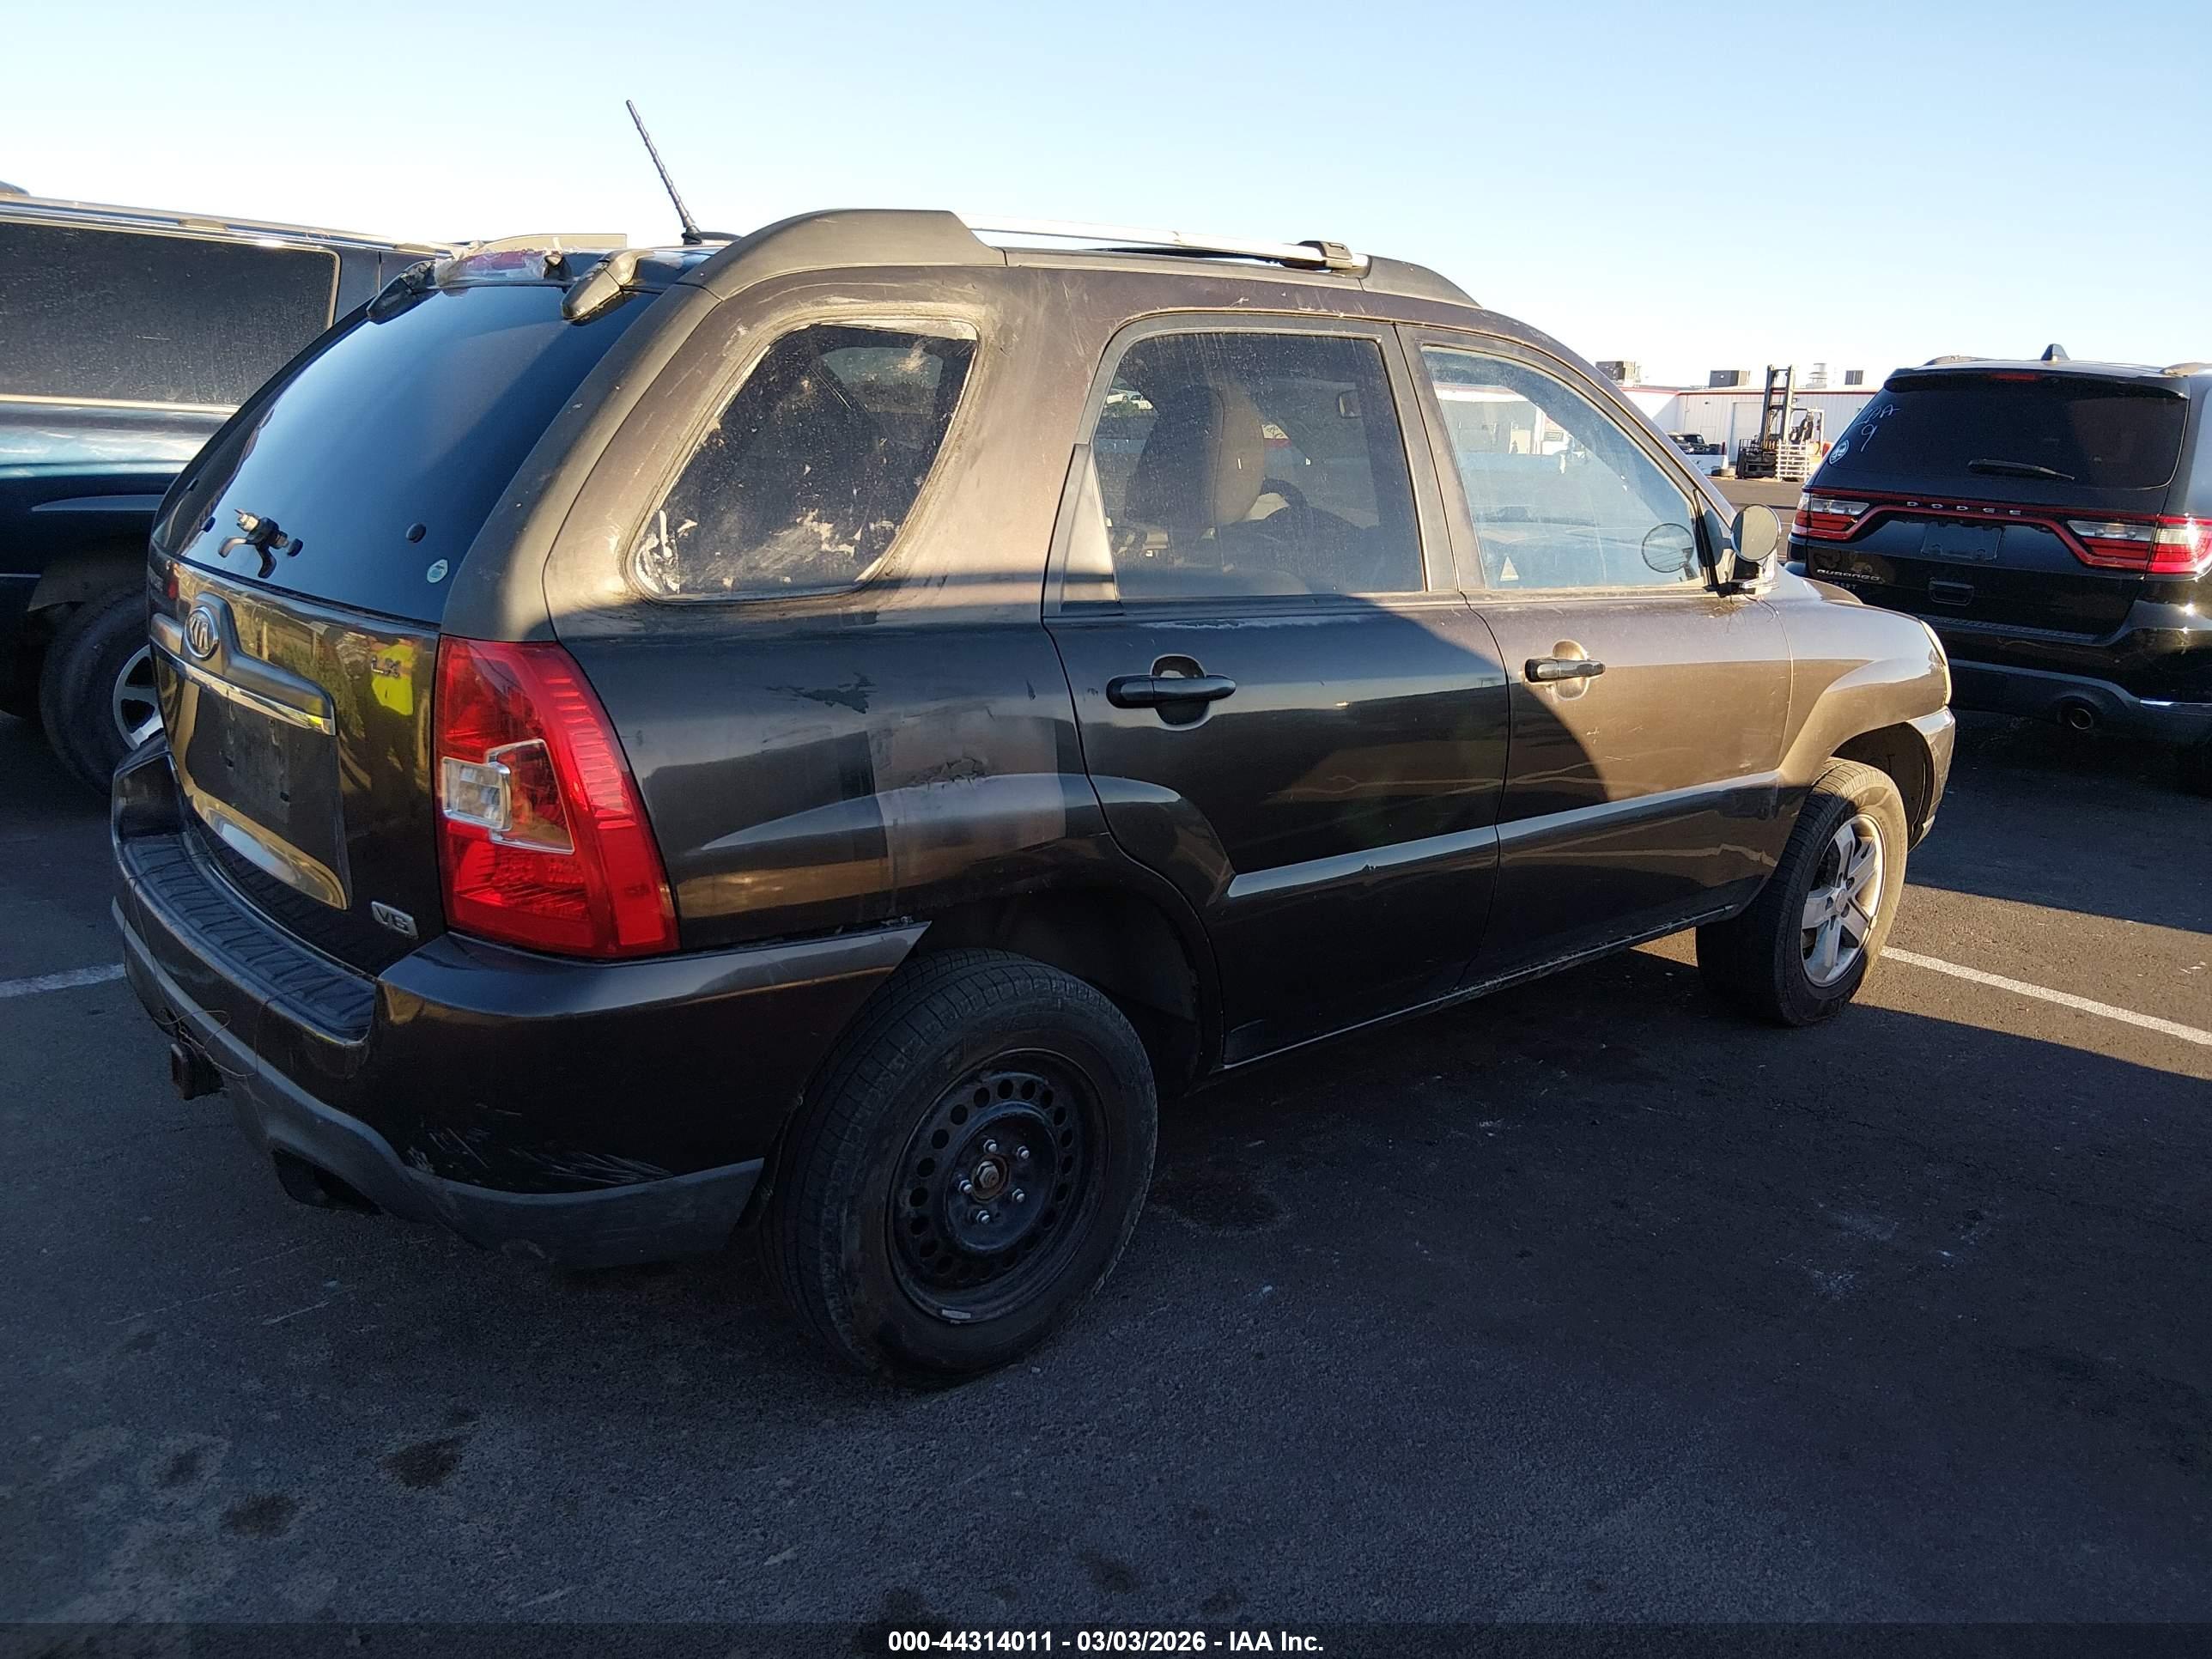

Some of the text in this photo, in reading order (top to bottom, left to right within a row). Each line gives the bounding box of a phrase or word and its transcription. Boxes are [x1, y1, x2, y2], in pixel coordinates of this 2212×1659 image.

[1860, 423, 1878, 453] 9
[1906, 501, 2021, 515] DODGE
[189, 617, 211, 652] KIA
[370, 655, 400, 678] LX
[376, 908, 410, 933] V6
